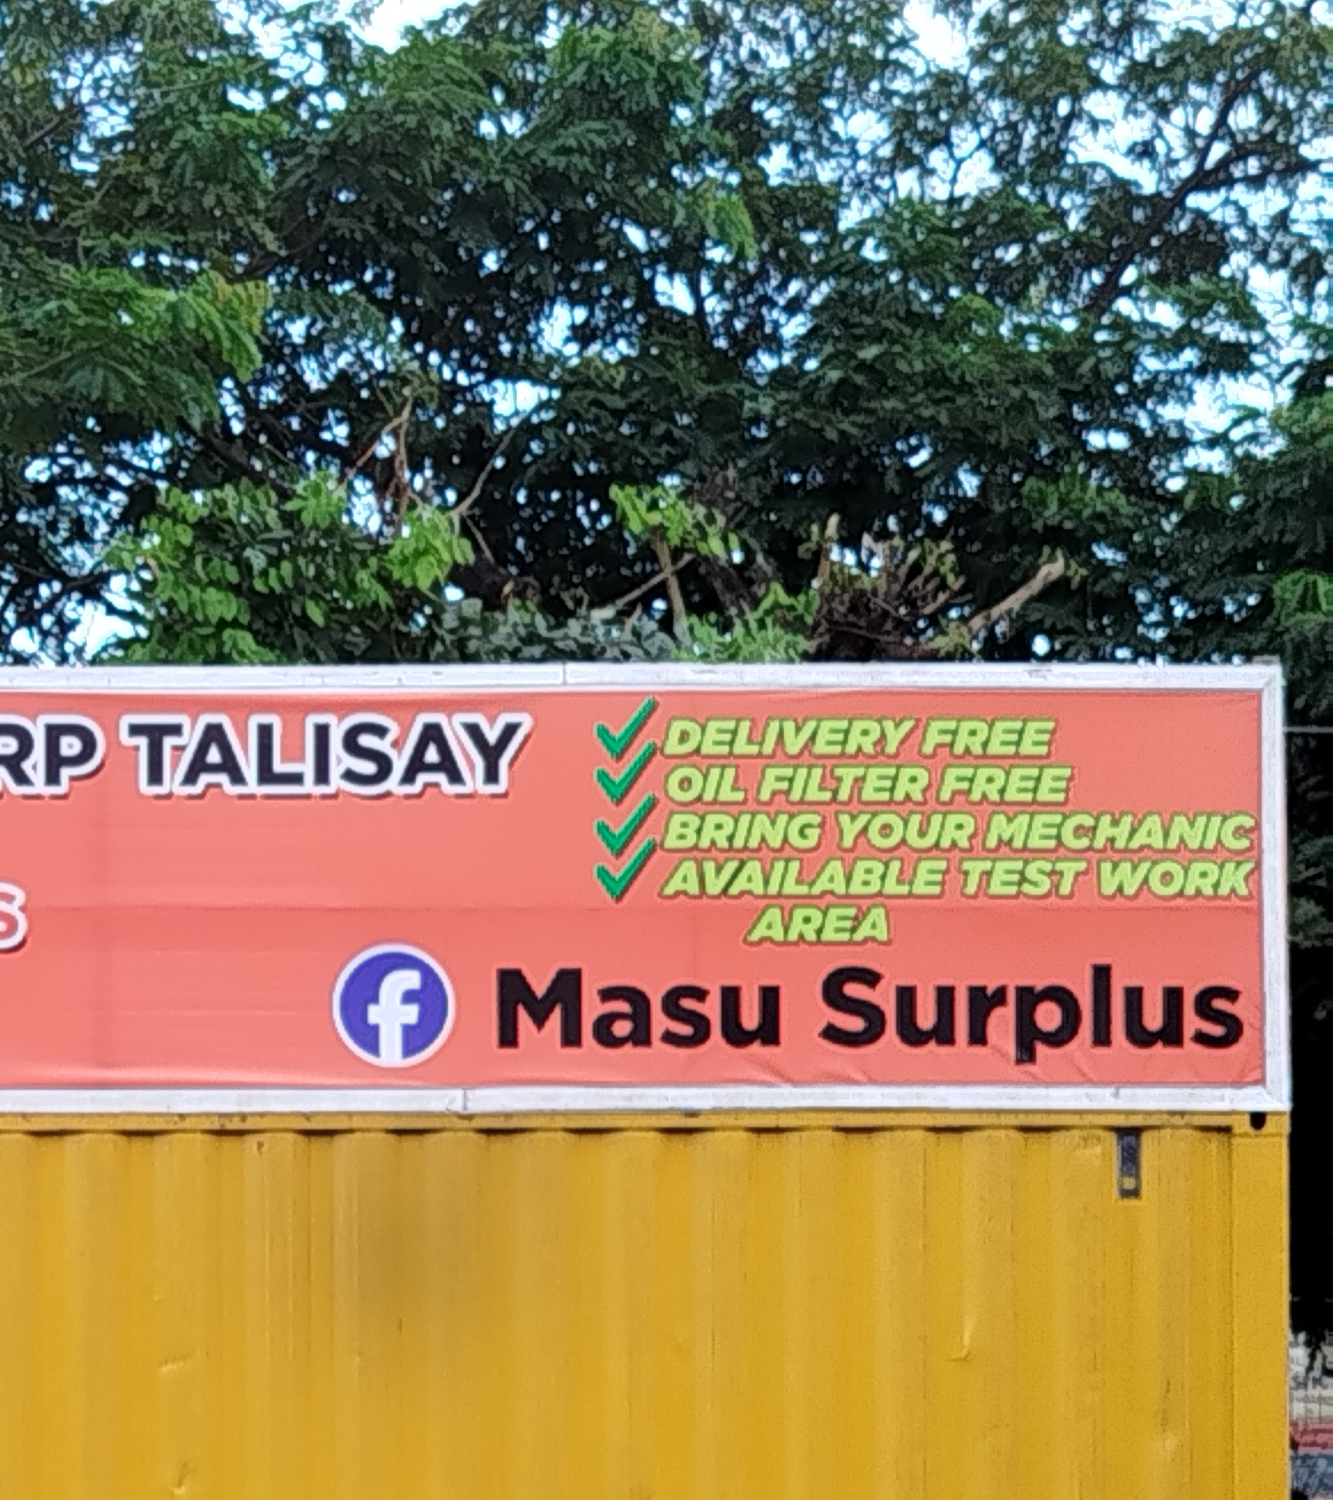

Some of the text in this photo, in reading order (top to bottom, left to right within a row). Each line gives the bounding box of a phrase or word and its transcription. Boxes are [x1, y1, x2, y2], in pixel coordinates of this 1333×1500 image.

[125, 718, 528, 790] TALISAY
[663, 718, 1056, 756] DELIVERY FREE
[664, 765, 1073, 803] OIL FILTER FREE
[663, 812, 1257, 850] BRING YOUR MECHANIC
[660, 858, 1257, 897] AVAILABLE TEST WORK
[744, 906, 890, 943] AREA
[496, 962, 1245, 1066] Masu Surplus
